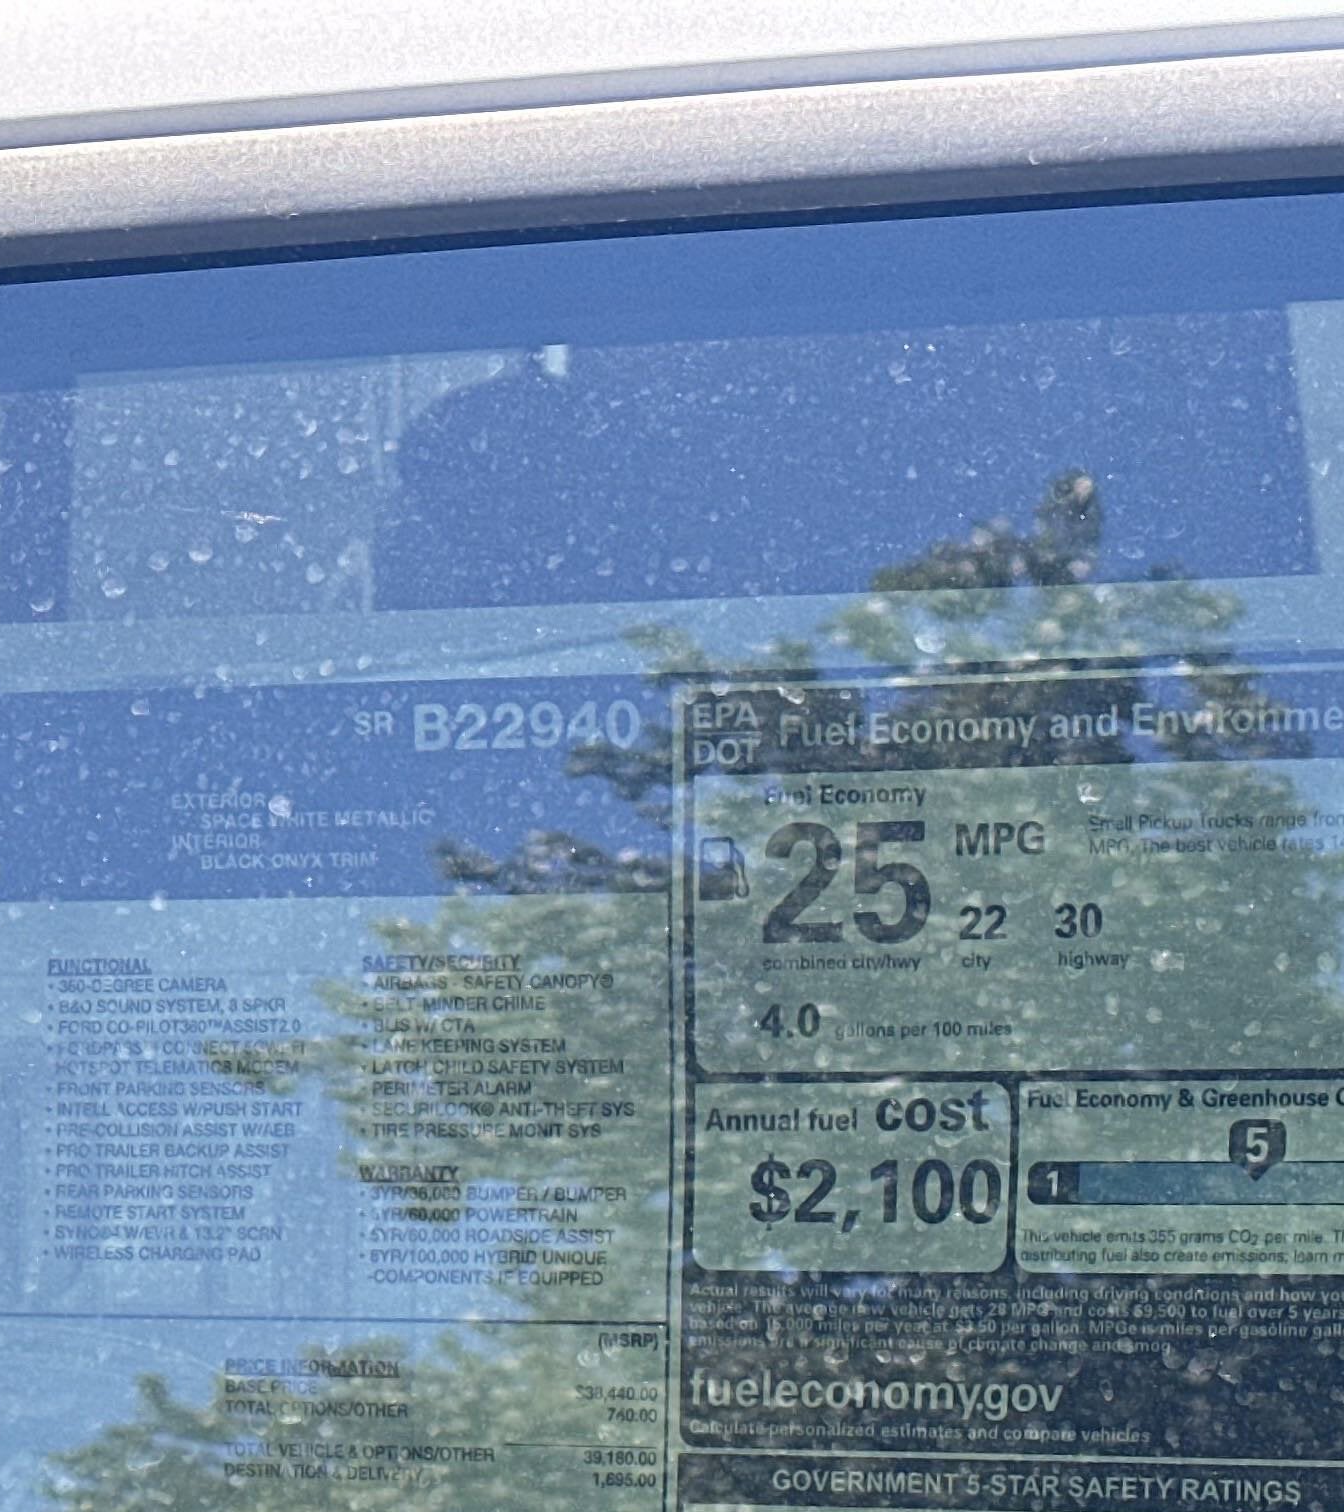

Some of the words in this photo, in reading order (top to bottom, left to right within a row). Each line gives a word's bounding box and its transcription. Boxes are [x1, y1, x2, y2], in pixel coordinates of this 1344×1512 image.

[355, 713, 393, 736] SR
[414, 701, 642, 752] B22940
[692, 701, 756, 729] EPA
[779, 714, 857, 747] Fuel
[869, 710, 1036, 749] Economy
[1050, 701, 1118, 738] and
[693, 737, 758, 765] DOT
[172, 793, 270, 810] EXTERIOR
[763, 785, 812, 806] Fuel
[820, 783, 926, 808] Economy
[201, 814, 262, 829] SPACE
[955, 822, 1045, 855] MPG
[200, 854, 264, 869] BLACK
[272, 853, 322, 869] ONYX
[329, 852, 377, 867] TRIM
[762, 820, 932, 944] 25
[959, 905, 1007, 940] 22
[1055, 902, 1102, 939] 30
[762, 952, 847, 971] combined
[853, 951, 921, 972] city/hwy
[962, 952, 991, 971] city
[1058, 949, 1129, 969] highway
[158, 977, 227, 993] CAMERA
[760, 1003, 820, 1038] 4.0
[835, 1021, 894, 1041] gallons
[900, 1023, 927, 1040] per
[933, 1021, 962, 1036] 100
[967, 1020, 1012, 1036] miles
[705, 1108, 799, 1132] Annual
[808, 1108, 857, 1131] fuel
[875, 1089, 990, 1131] cost
[1027, 1091, 1070, 1108] Fuel
[1076, 1089, 1170, 1109] Economy
[1178, 1091, 1193, 1107] &
[1199, 1087, 1332, 1109] Greenhouse
[1245, 1126, 1268, 1160] 5
[749, 1153, 1003, 1232] $2,100
[1047, 1171, 1059, 1197] 1
[690, 1368, 1063, 1418] fueleconomy.gov
[772, 1470, 958, 1494] GOVERNMENT
[966, 1472, 1059, 1498] 5-STAR
[1068, 1477, 1173, 1498] SAFETY
[1181, 1479, 1301, 1502] RATINGS
